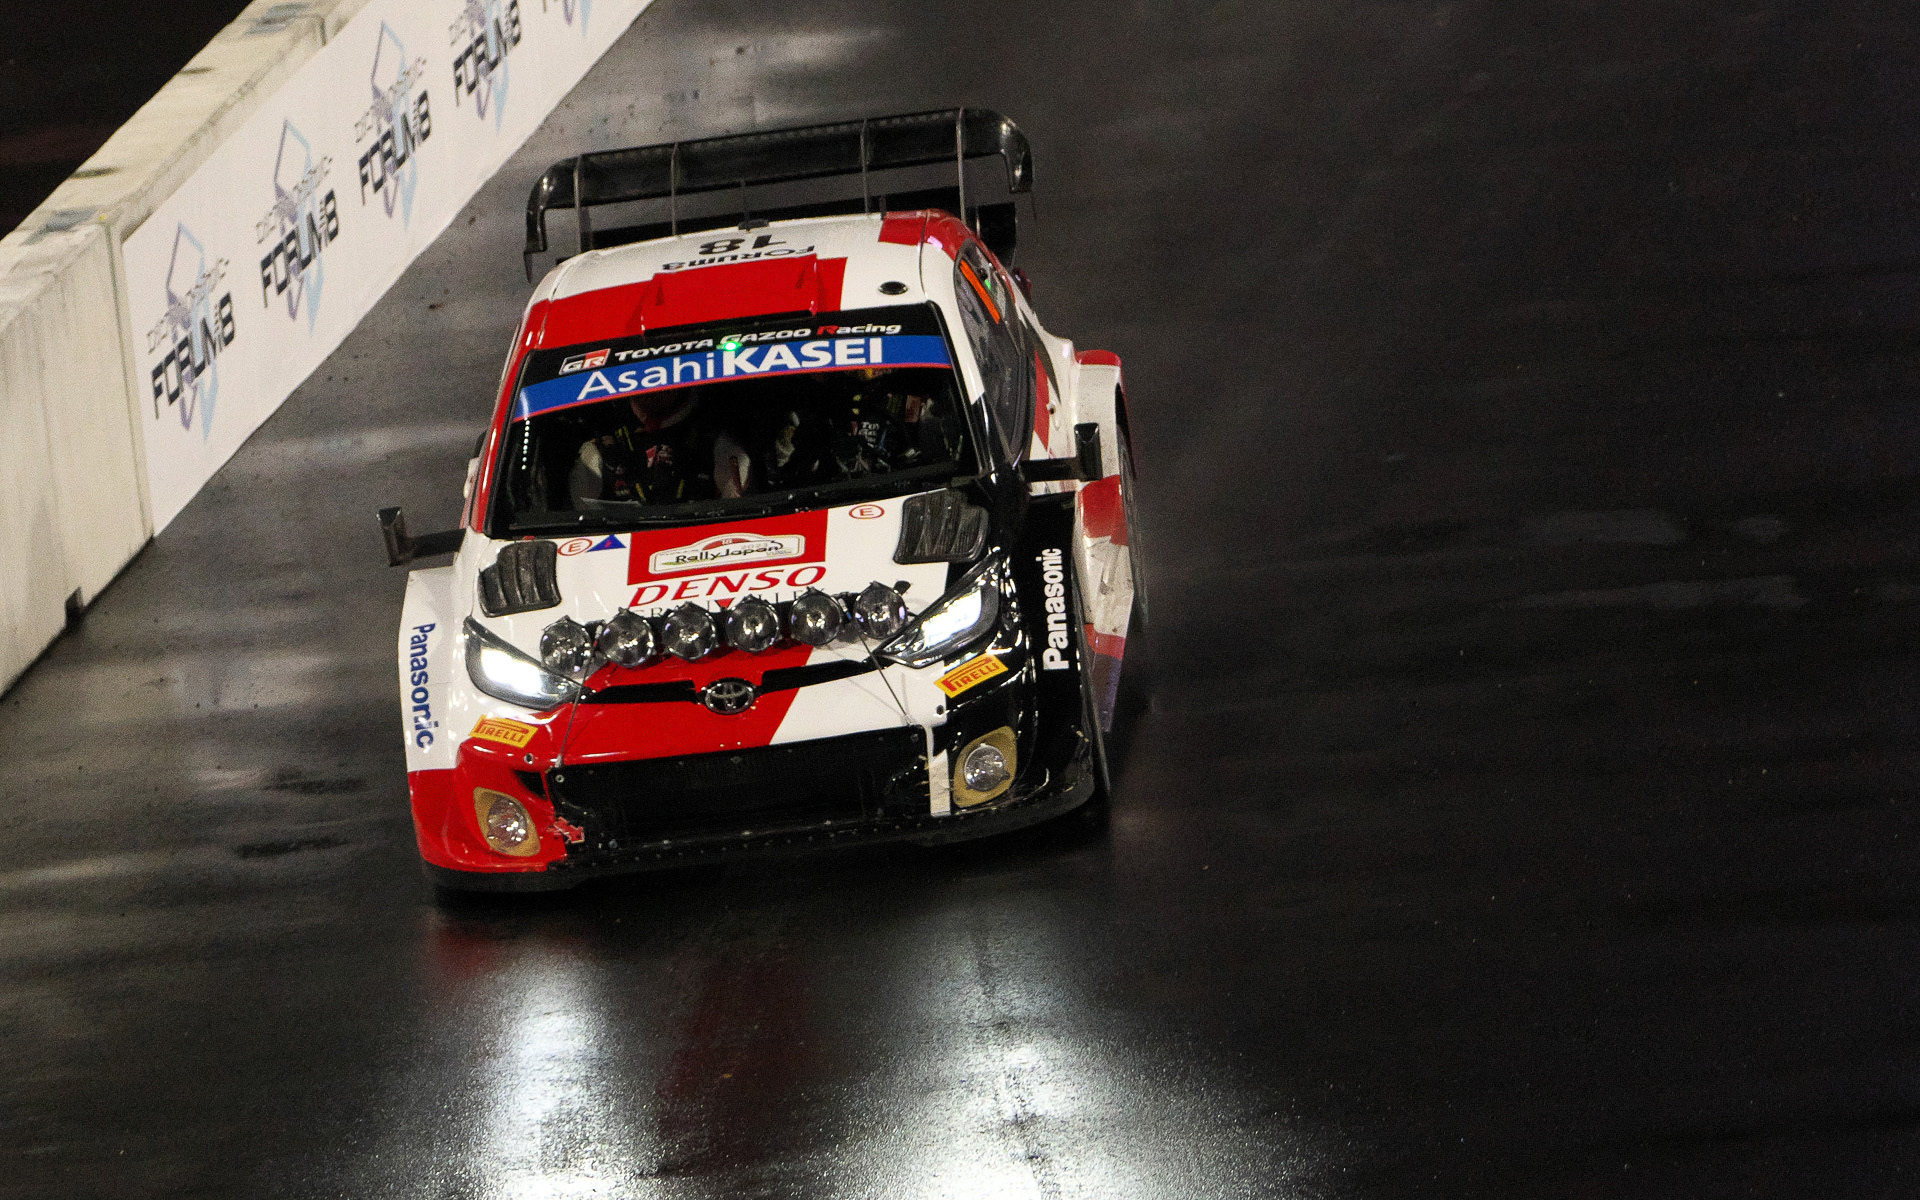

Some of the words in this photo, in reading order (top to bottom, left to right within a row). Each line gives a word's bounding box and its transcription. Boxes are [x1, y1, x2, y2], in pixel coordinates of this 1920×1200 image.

[698, 234, 787, 255] 18
[614, 338, 714, 361] TOYOTA
[816, 323, 902, 335] Racing
[562, 355, 605, 372] GR
[628, 565, 827, 608] DENSO
[1035, 547, 1070, 671] Panasonic
[410, 622, 439, 749] Panasonic
[942, 656, 1000, 692] PIRELLI
[474, 719, 530, 743] PIRELLI
